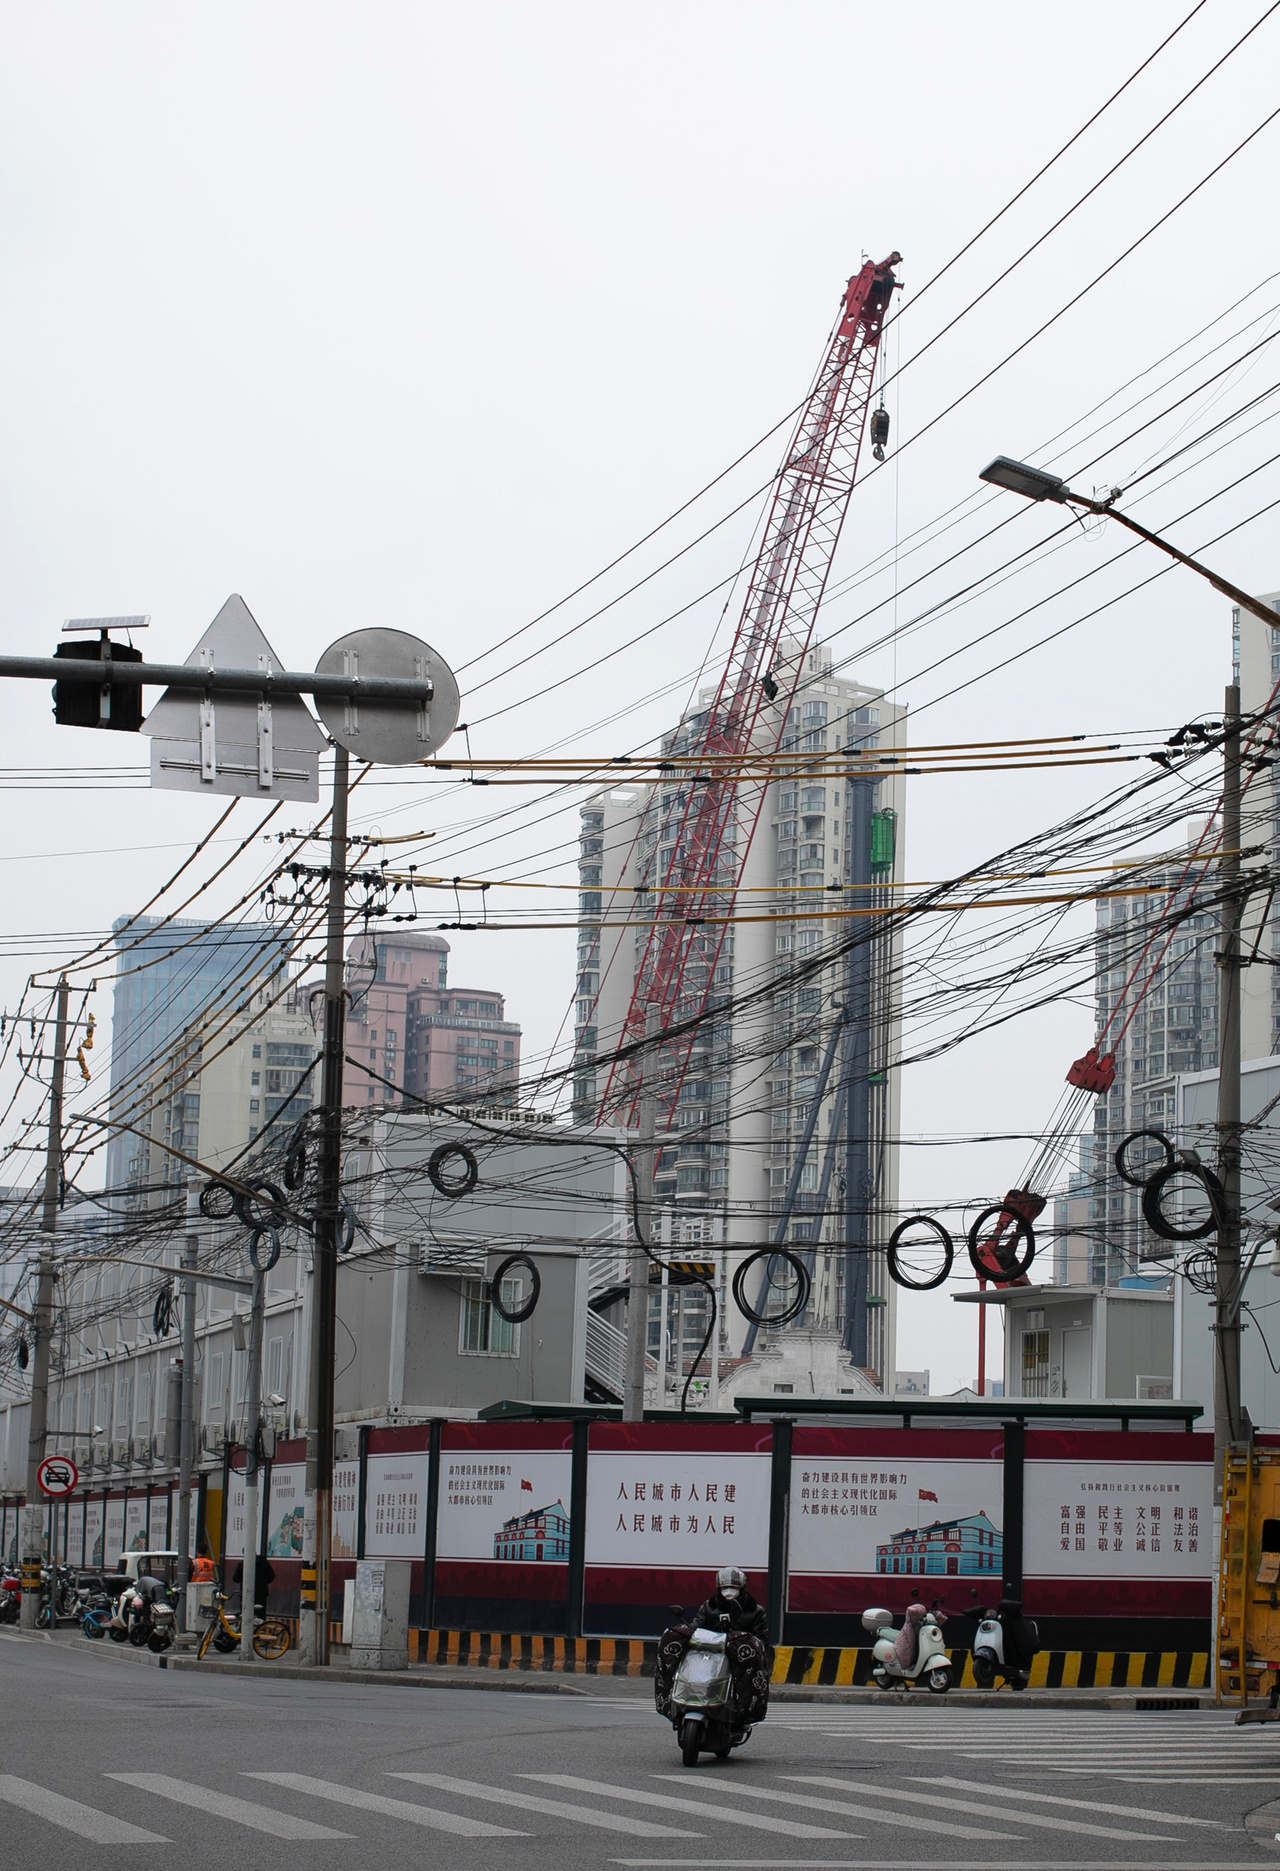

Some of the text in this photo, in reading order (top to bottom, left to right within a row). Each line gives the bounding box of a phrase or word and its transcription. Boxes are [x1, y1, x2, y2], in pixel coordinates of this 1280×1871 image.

[802, 1471, 908, 1485] 奋力建设具有世界影响力
[616, 1482, 737, 1503] 人民城市人民建
[801, 1487, 898, 1501] 的社会主义现代化国际
[801, 1503, 878, 1517] 大都市核心引领区
[1061, 1505, 1198, 1521] 富强 民主 文明 和谐
[615, 1513, 735, 1535] 人民城市为人民
[1061, 1521, 1198, 1537] 自由 平等 公正 法治
[1060, 1538, 1198, 1552] 爱国 敬业 诚信 友善
